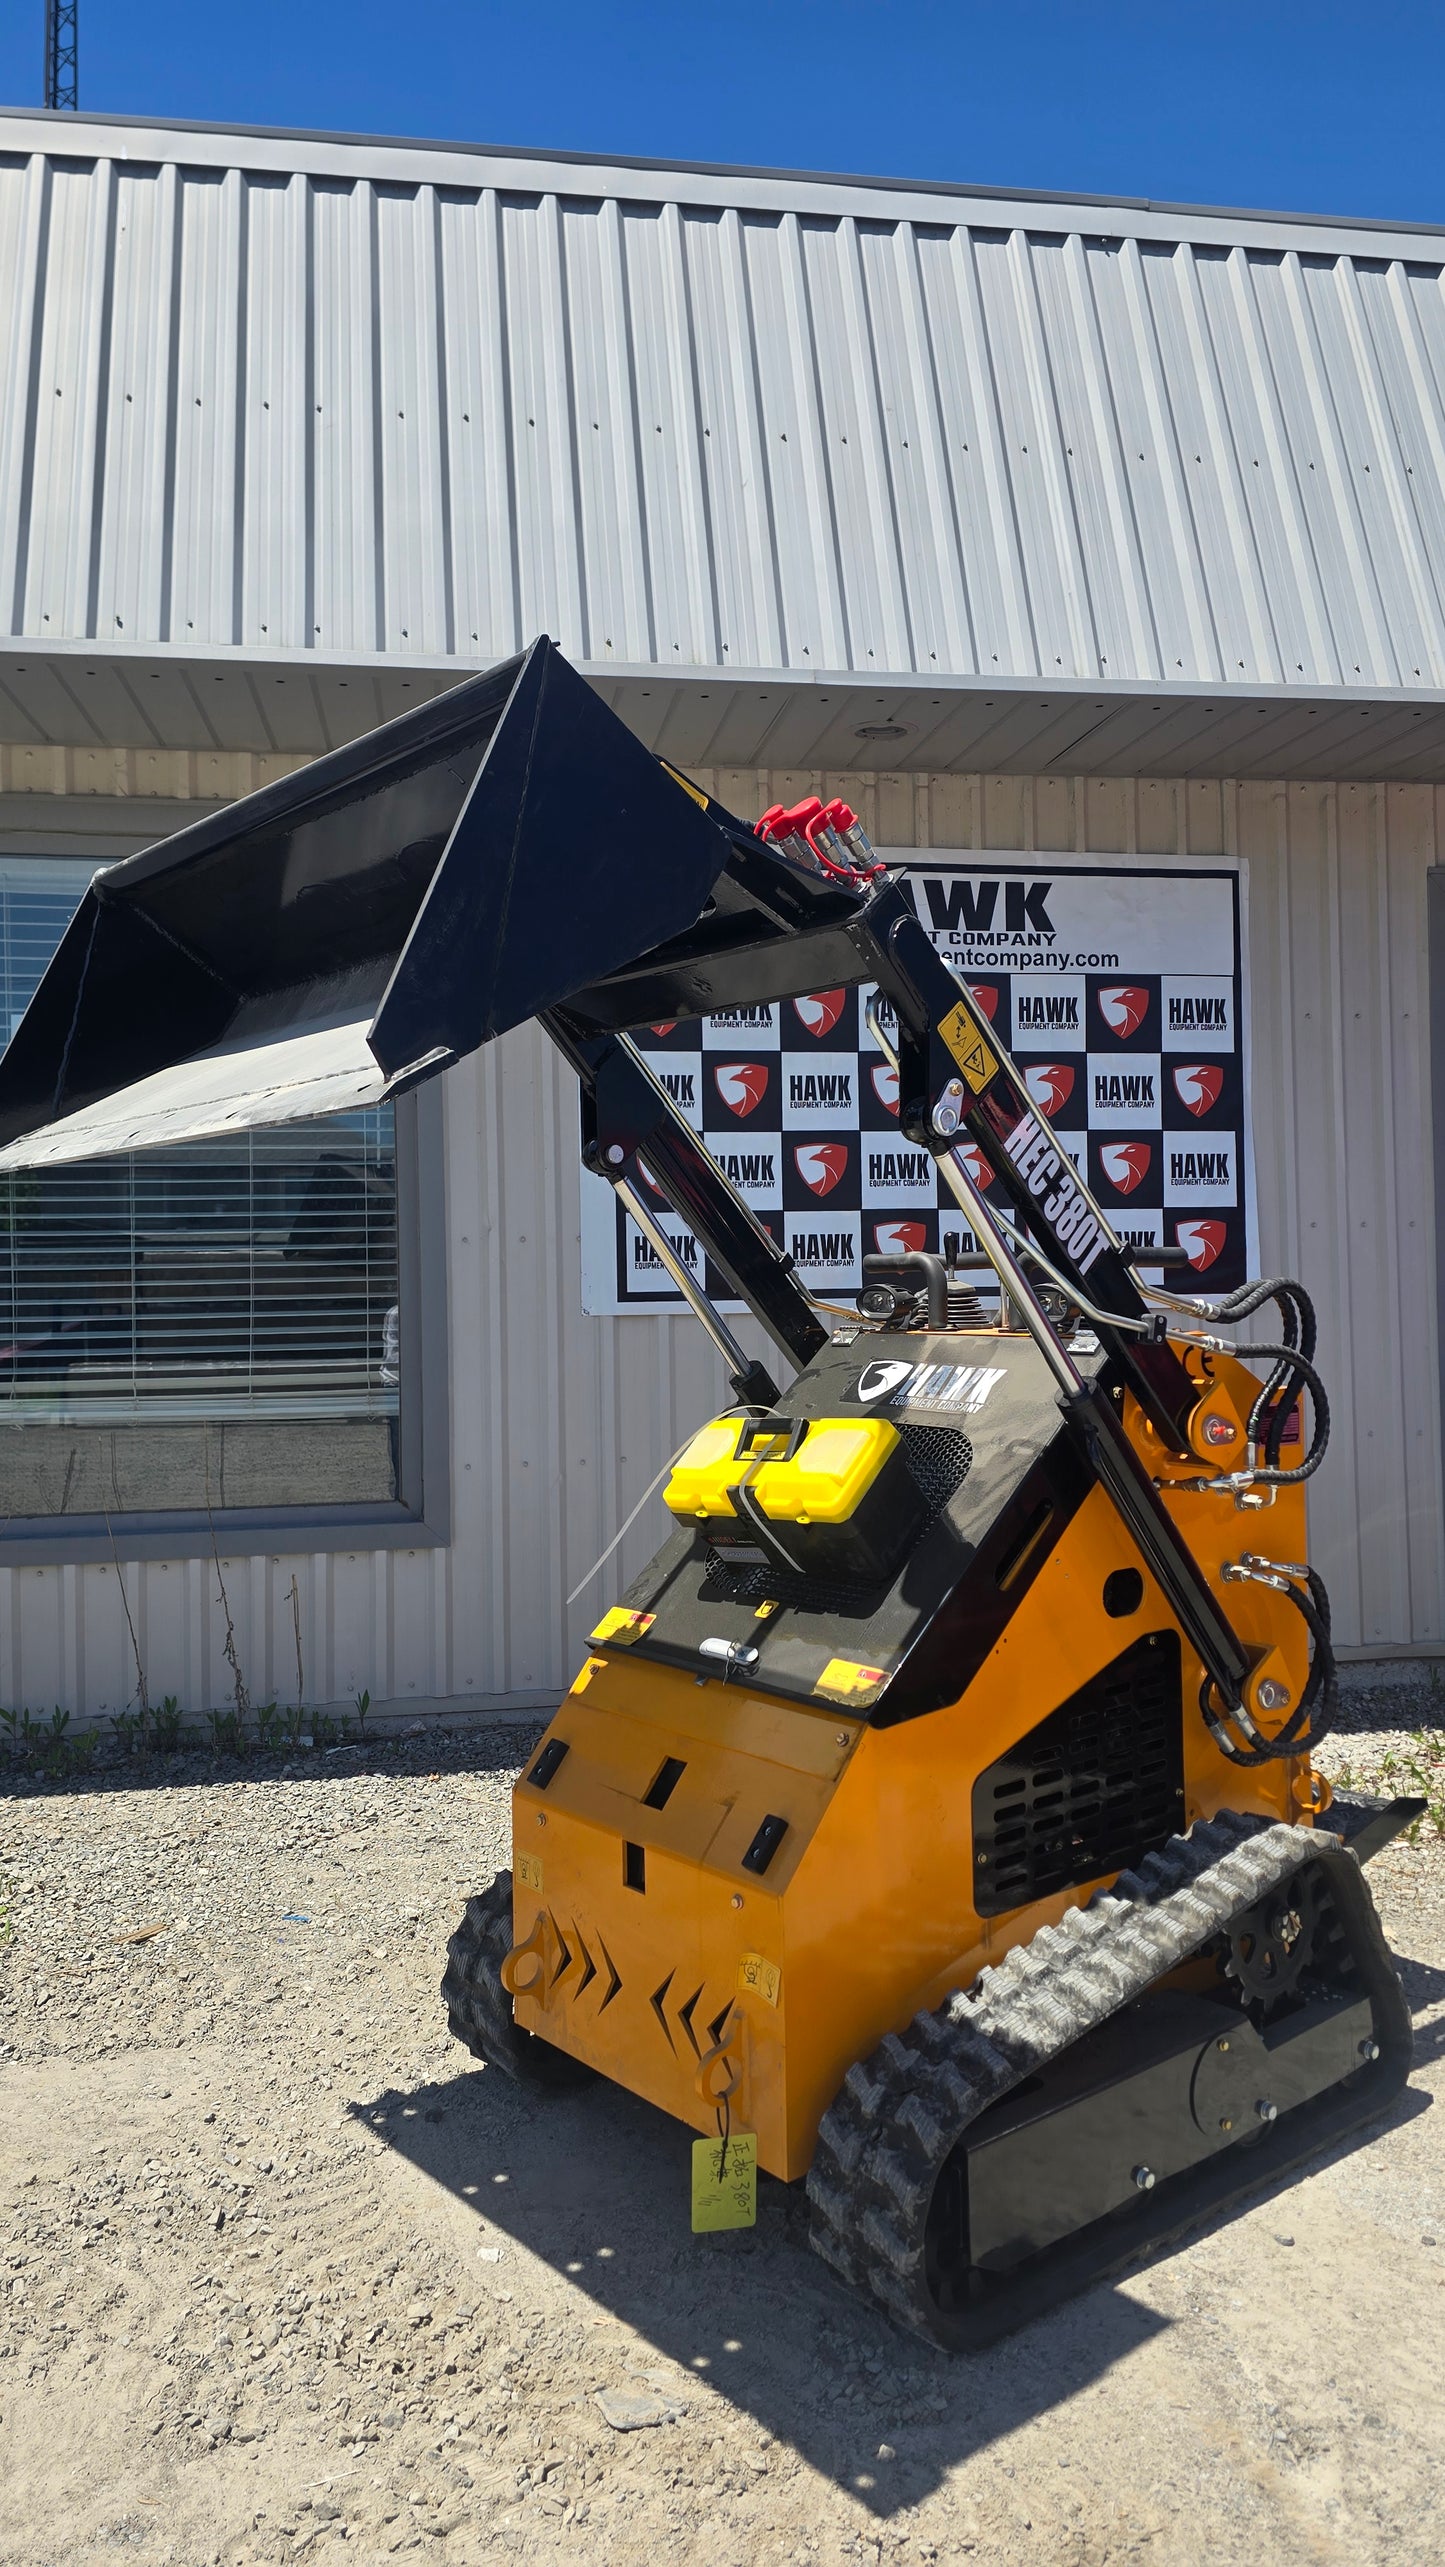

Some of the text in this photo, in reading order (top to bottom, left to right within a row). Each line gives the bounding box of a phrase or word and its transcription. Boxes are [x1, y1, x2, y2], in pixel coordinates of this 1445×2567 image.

[897, 879, 1056, 932] WK
[949, 931, 1057, 946] COMPANY
[938, 948, 1119, 971] entcompany.com
[711, 1004, 772, 1021] WK
[1019, 997, 1079, 1023] HAWK
[1169, 998, 1227, 1024] HAWK
[710, 1021, 743, 1029] EQUIPMENT
[1018, 1023, 1050, 1031] EQUIPMENT
[660, 1075, 695, 1100] WK
[790, 1075, 851, 1101] HAWK
[1095, 1075, 1154, 1100] HAWK
[790, 1101, 822, 1109] EQUIPMENT
[869, 1154, 930, 1180] HAWK
[1171, 1153, 1229, 1178] HAWK
[869, 1180, 902, 1188] EQUIPMENT
[1170, 1178, 1230, 1186] EQUIPMENT COMPANY
[792, 1234, 854, 1259] HAWK
[634, 1262, 665, 1270] EQUIPMEN
[897, 1362, 1008, 1404] HAWK
[889, 1396, 984, 1414] EQUIPMENT COMPANY
